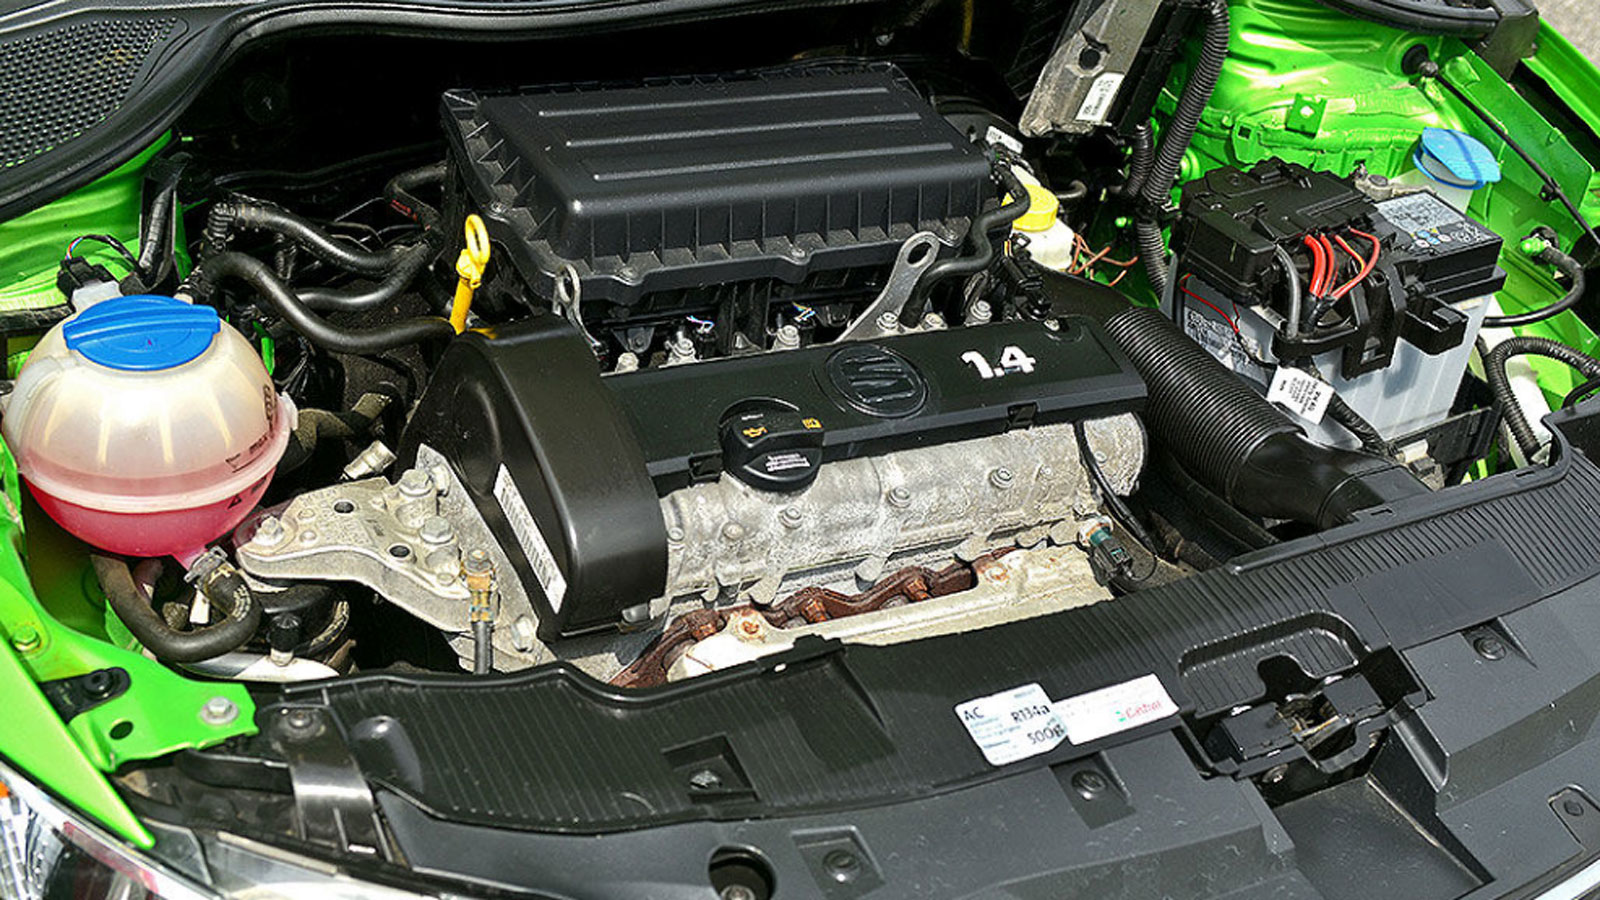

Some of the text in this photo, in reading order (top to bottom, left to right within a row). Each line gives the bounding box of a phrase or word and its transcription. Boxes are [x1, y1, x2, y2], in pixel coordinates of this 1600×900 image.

[961, 346, 1036, 379] 1.4
[964, 706, 984, 721] AC
[1010, 704, 1050, 723] R134a
